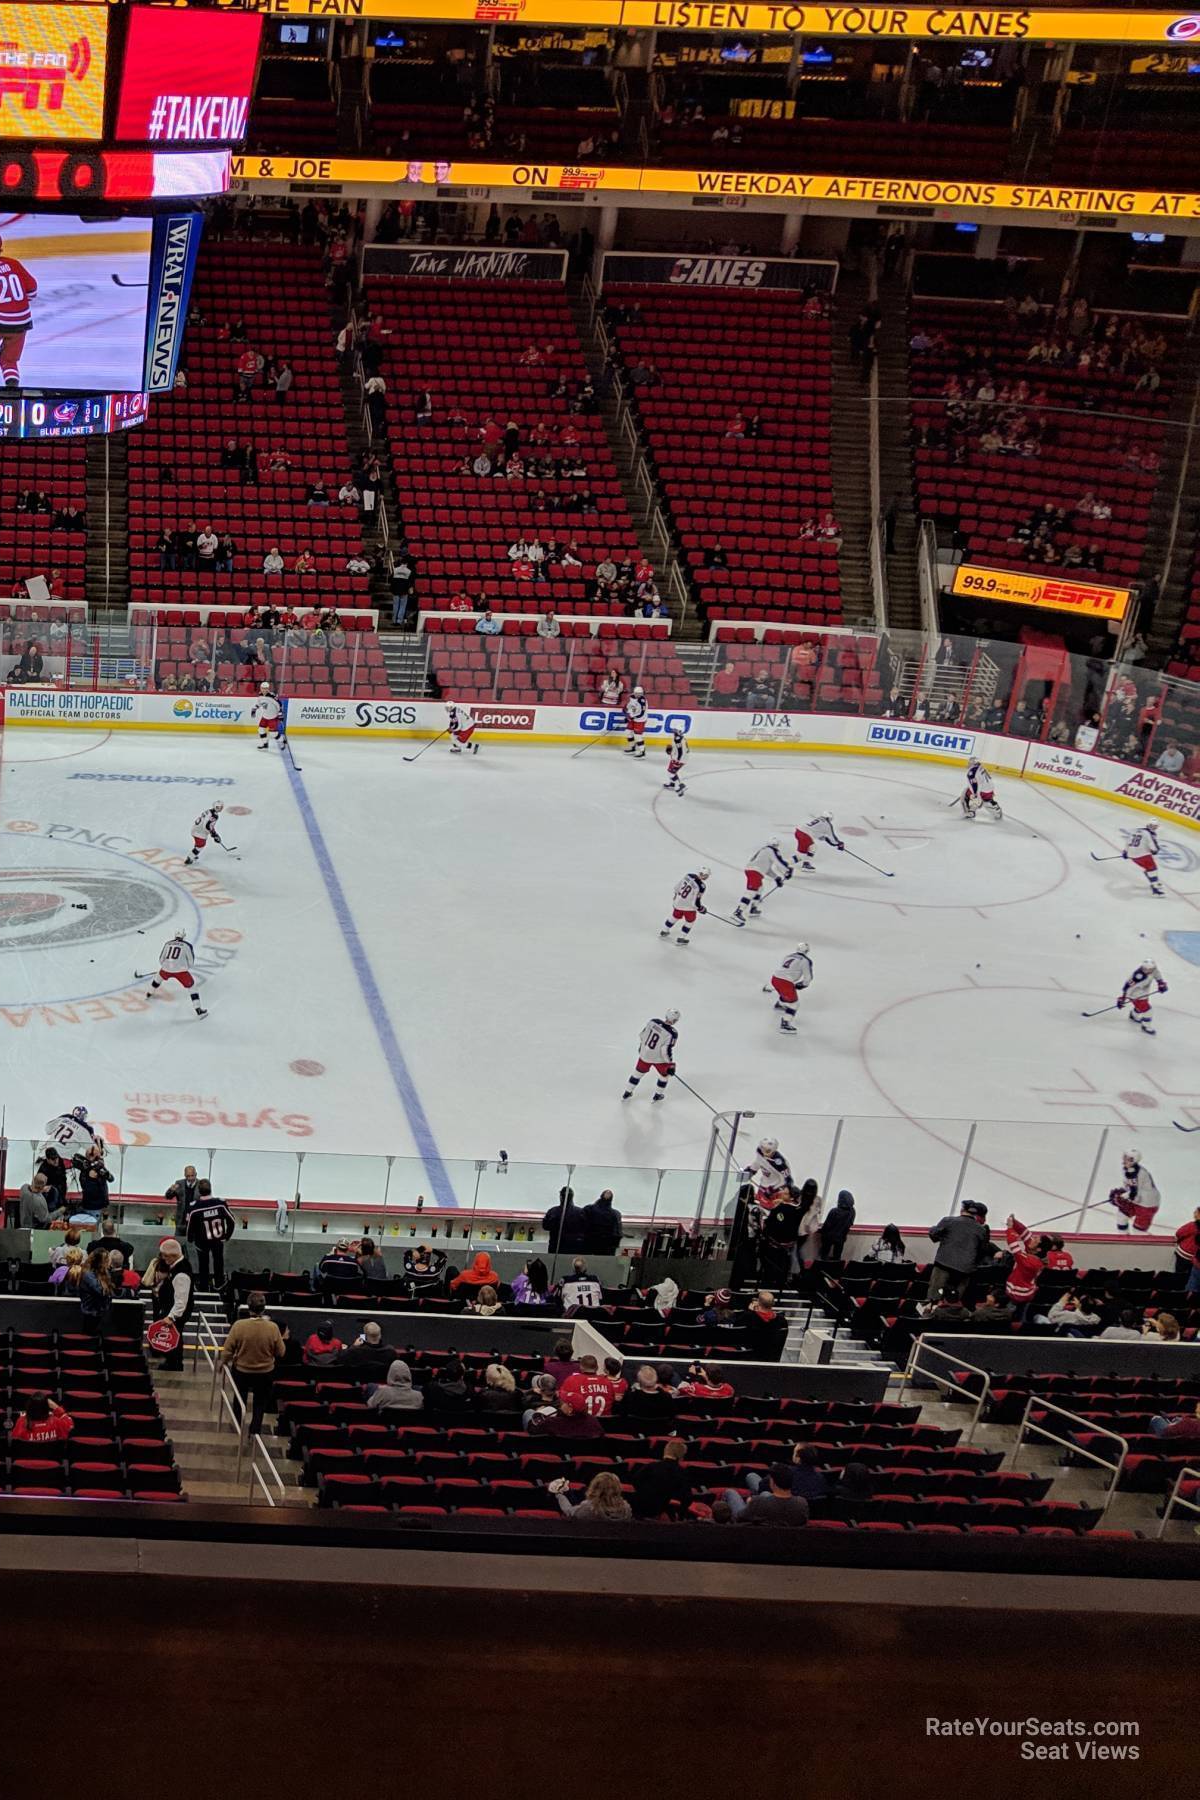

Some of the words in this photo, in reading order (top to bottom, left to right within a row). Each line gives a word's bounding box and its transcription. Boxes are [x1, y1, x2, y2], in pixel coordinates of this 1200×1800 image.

[655, 3, 754, 27] LISTEN
[769, 6, 806, 31] TO
[826, 7, 908, 34] YOUR
[926, 9, 1030, 38] CANES
[32, 52, 67, 67] FAN
[259, 159, 274, 176] &
[288, 159, 331, 178] JOE
[512, 167, 548, 186] ON
[697, 173, 813, 195] WEEKDAY
[825, 179, 995, 204] AFTERNOONS
[1009, 188, 1135, 212] STARTING
[1151, 195, 1185, 215] AT
[161, 221, 190, 297] WRAL
[409, 252, 448, 273] TAKE
[455, 251, 528, 278] WARNING
[669, 258, 767, 287] CANES
[152, 301, 177, 387] NEWS
[32, 403, 45, 425] 0
[40, 427, 60, 436] BLUE
[62, 425, 94, 436] JACKETS
[962, 575, 997, 592] 99.9
[1042, 581, 1116, 609] ESPN
[9, 692, 54, 709] RALEIGH
[58, 694, 133, 711] ORTHOPAEDIC
[302, 705, 346, 714] ANALYTICS
[20, 709, 55, 718] OFFICIAL
[58, 710, 81, 718] TEAM
[84, 711, 121, 719] DOCTORS
[195, 707, 242, 722] Lottery
[374, 706, 416, 724] sas
[475, 711, 529, 725] Lenovo
[579, 711, 692, 734] GECO
[751, 713, 792, 728] DNA
[871, 726, 911, 743] BUD
[913, 733, 971, 750] LIGHT
[66, 772, 236, 787] ticketmaster
[1127, 772, 1200, 806] Advance
[1115, 783, 1153, 803] Auto
[45, 822, 132, 850] PNC
[128, 847, 236, 909] ARENA
[166, 946, 181, 960] 10
[645, 1031, 659, 1050] 18
[124, 1091, 217, 1107] Health
[124, 1108, 315, 1138] Syneos
[204, 1219, 224, 1240] 10
[576, 1293, 593, 1306] 11
[590, 1385, 609, 1394] STAAL
[585, 1396, 605, 1416] 12
